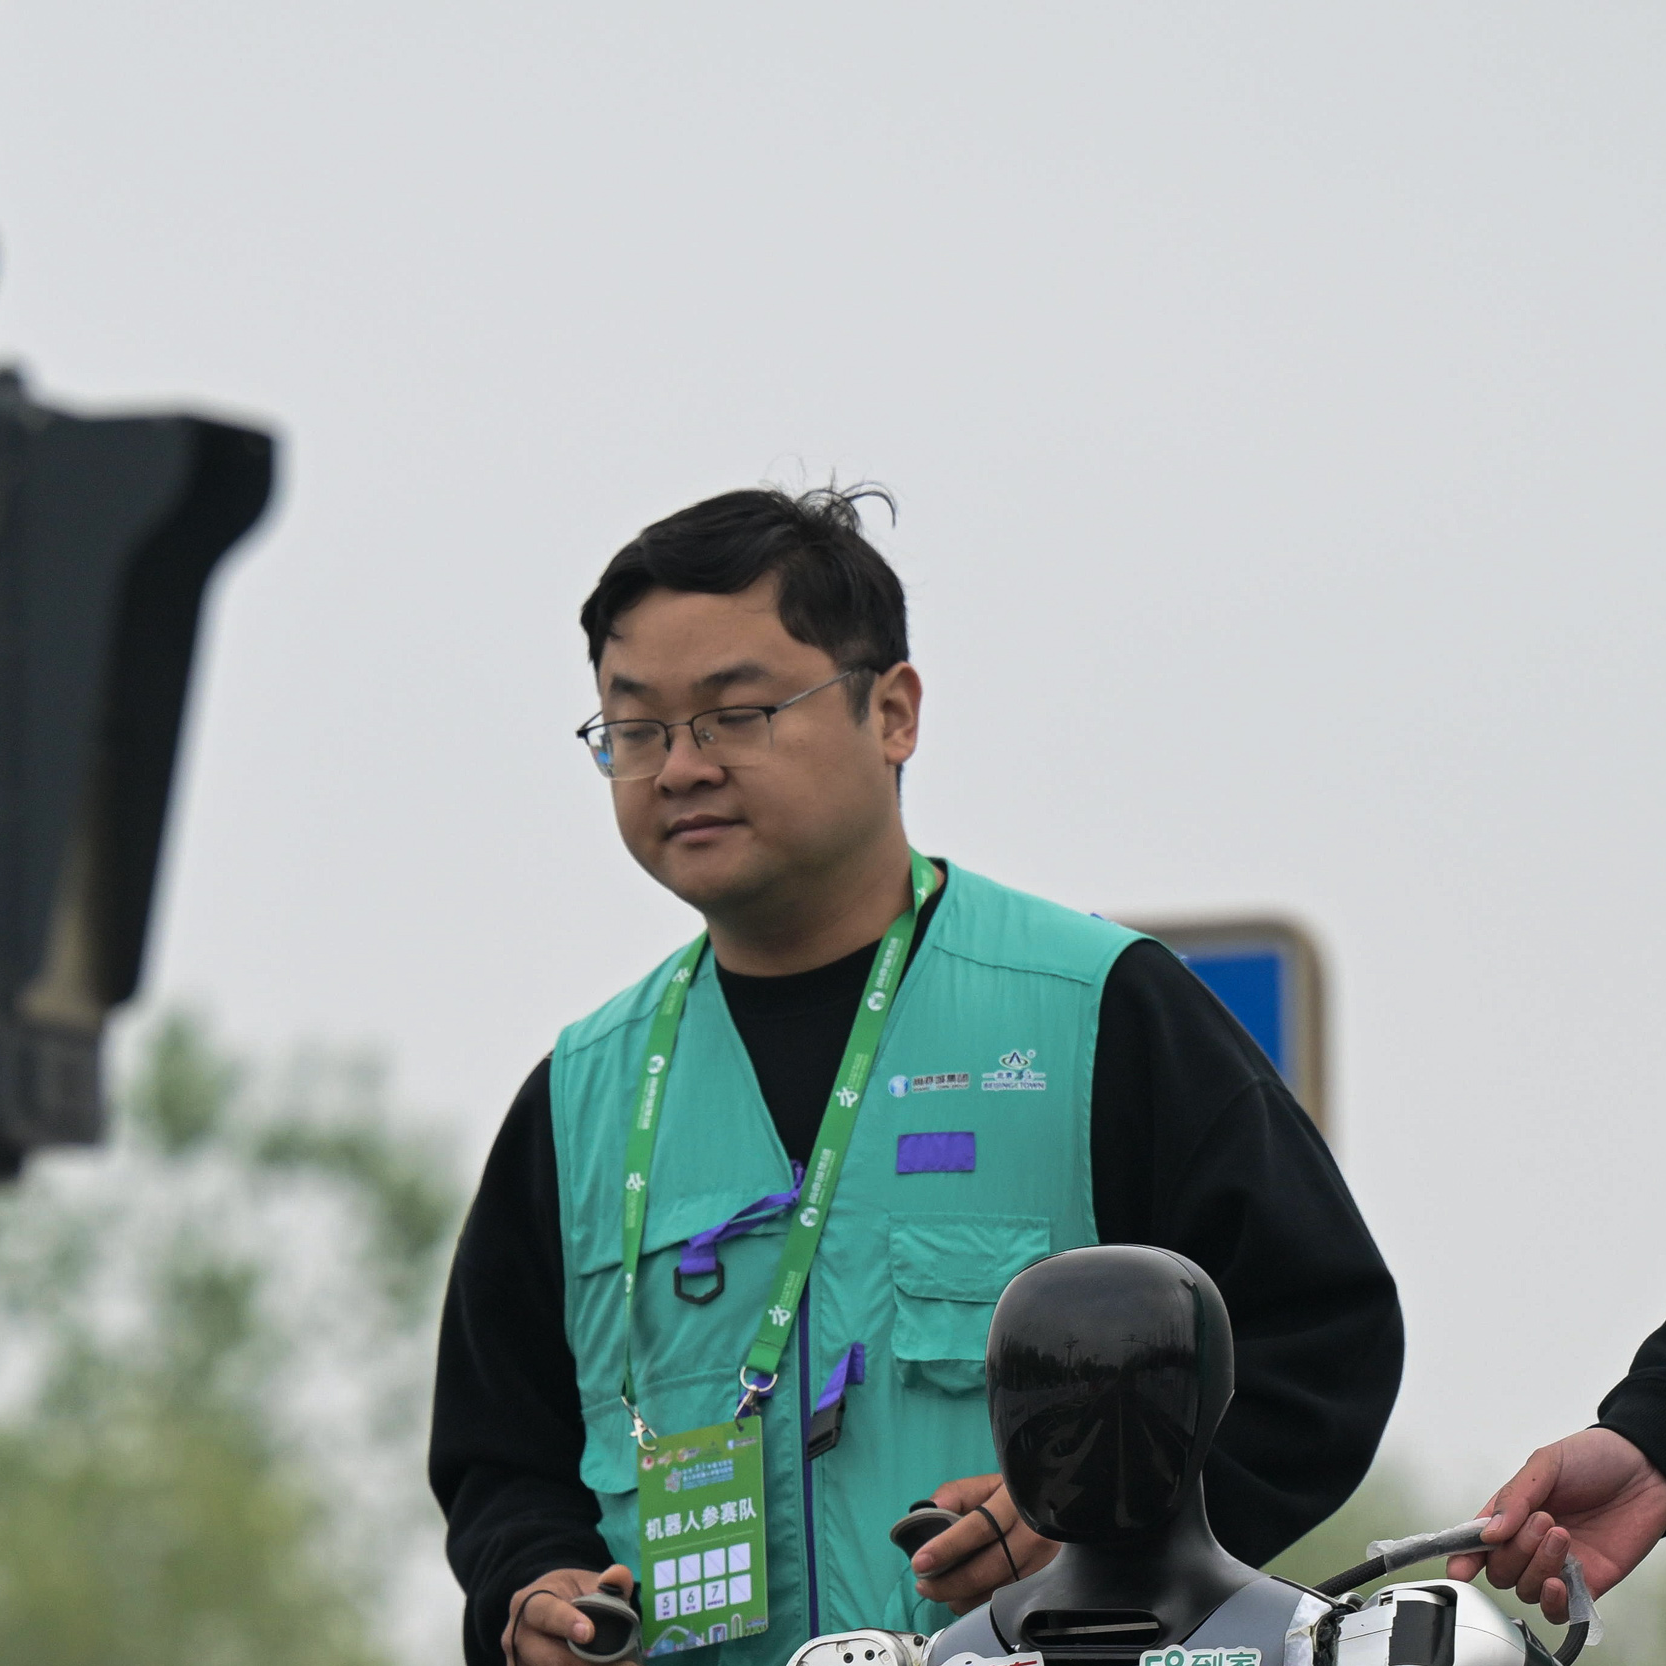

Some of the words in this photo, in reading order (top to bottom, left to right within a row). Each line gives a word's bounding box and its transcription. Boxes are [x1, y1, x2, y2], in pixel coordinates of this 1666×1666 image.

[645, 1497, 757, 1542] 机器人参赛队
[687, 1591, 695, 1603] 6
[711, 1585, 719, 1599] 7
[662, 1596, 670, 1609] 5
